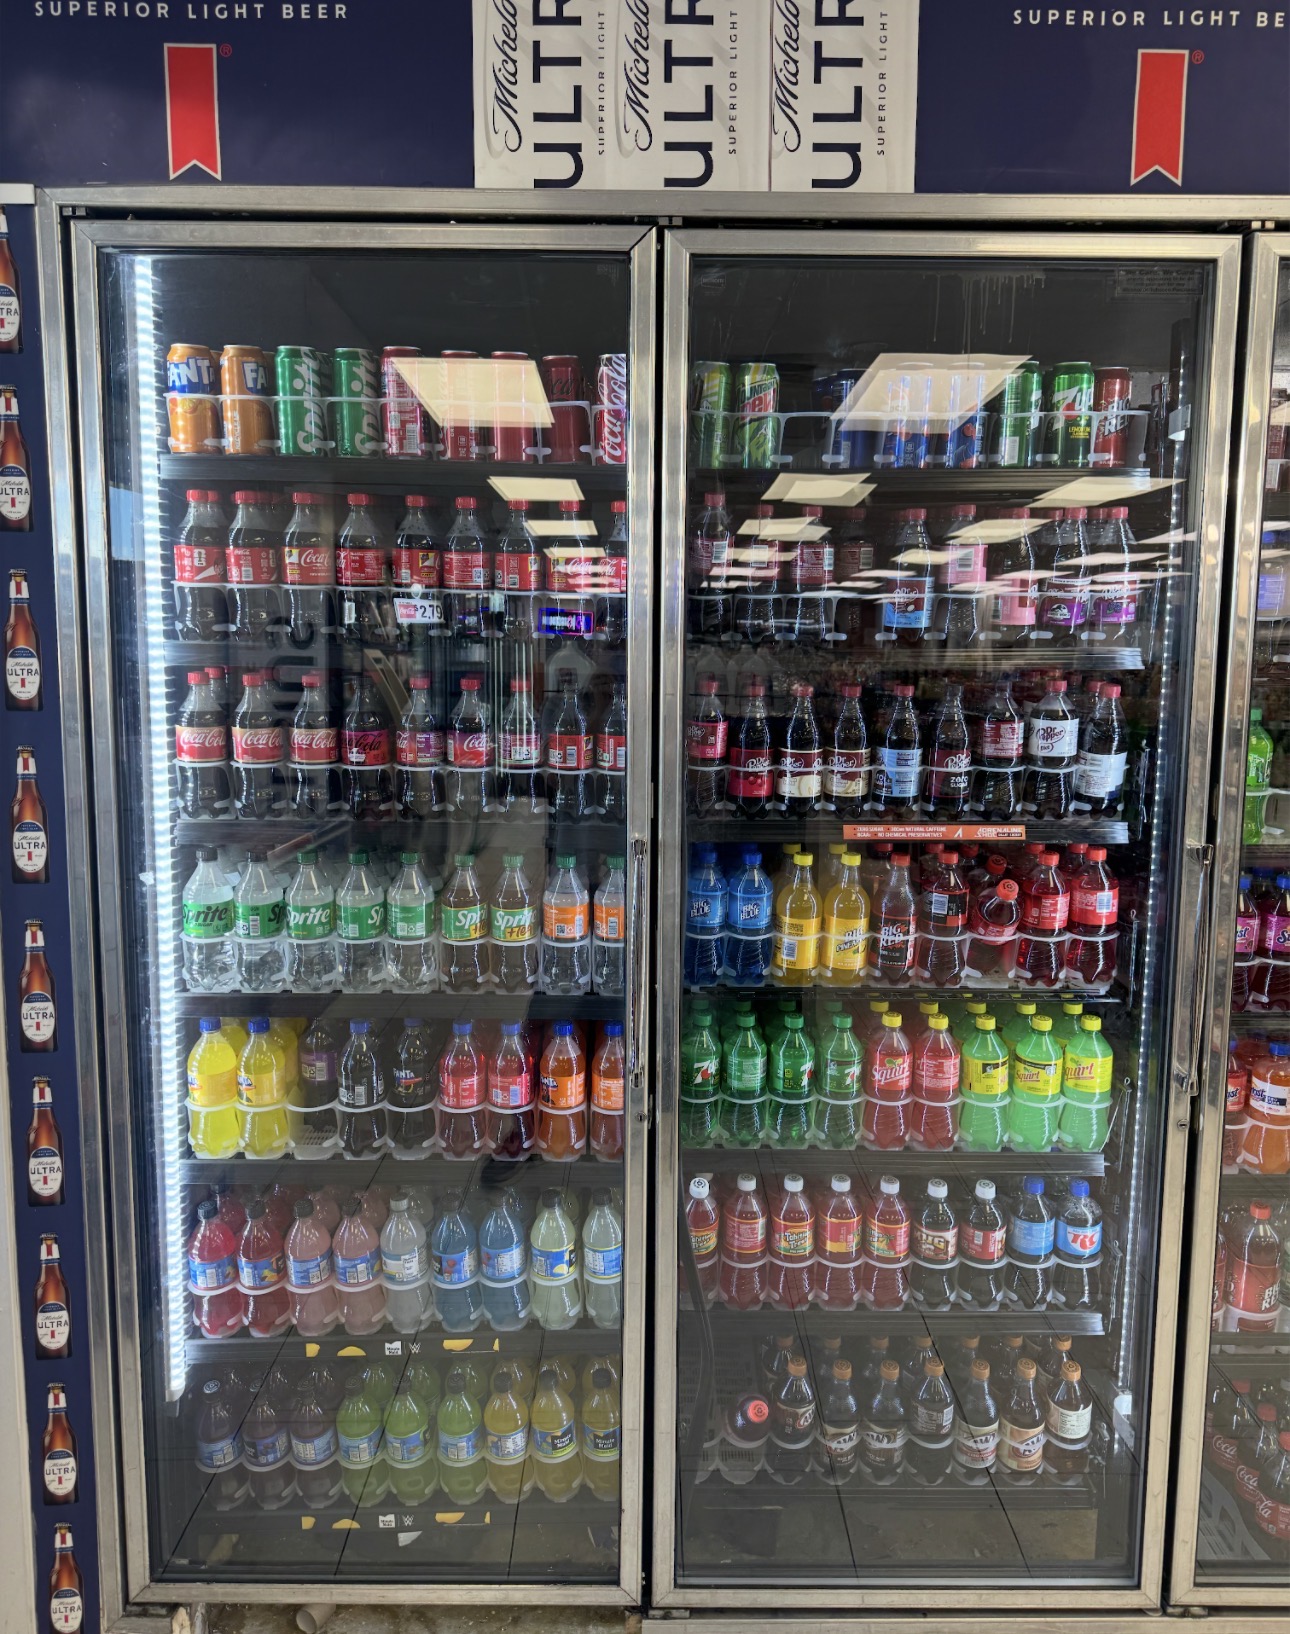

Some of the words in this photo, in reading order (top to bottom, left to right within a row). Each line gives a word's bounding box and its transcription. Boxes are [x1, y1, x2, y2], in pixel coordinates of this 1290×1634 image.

[35, 2, 169, 18] SUPERIOR
[187, 3, 264, 19] LIGHT
[282, 4, 347, 19] BEER
[1013, 9, 1145, 26] SUPERIOR
[1163, 9, 1241, 26] LIGHT
[1256, 11, 1285, 28] BE
[728, 10, 738, 60] LIGHT
[876, 11, 888, 61] LIGHT
[728, 70, 738, 155] SUPERIOR
[876, 72, 888, 156] SUPERIOR
[7, 668, 40, 677] ULTRA
[14, 841, 46, 850] ULTRA
[286, 906, 331, 926] Sprite
[22, 1011, 55, 1020] ULTRA
[873, 1062, 910, 1086] Squirt
[1015, 1070, 1041, 1082] Squirt
[30, 1156, 62, 1165] ULTRA
[38, 1320, 69, 1329] ULTRA
[45, 1456, 76, 1465] ULTRA
[52, 1604, 82, 1614] ULTRA
